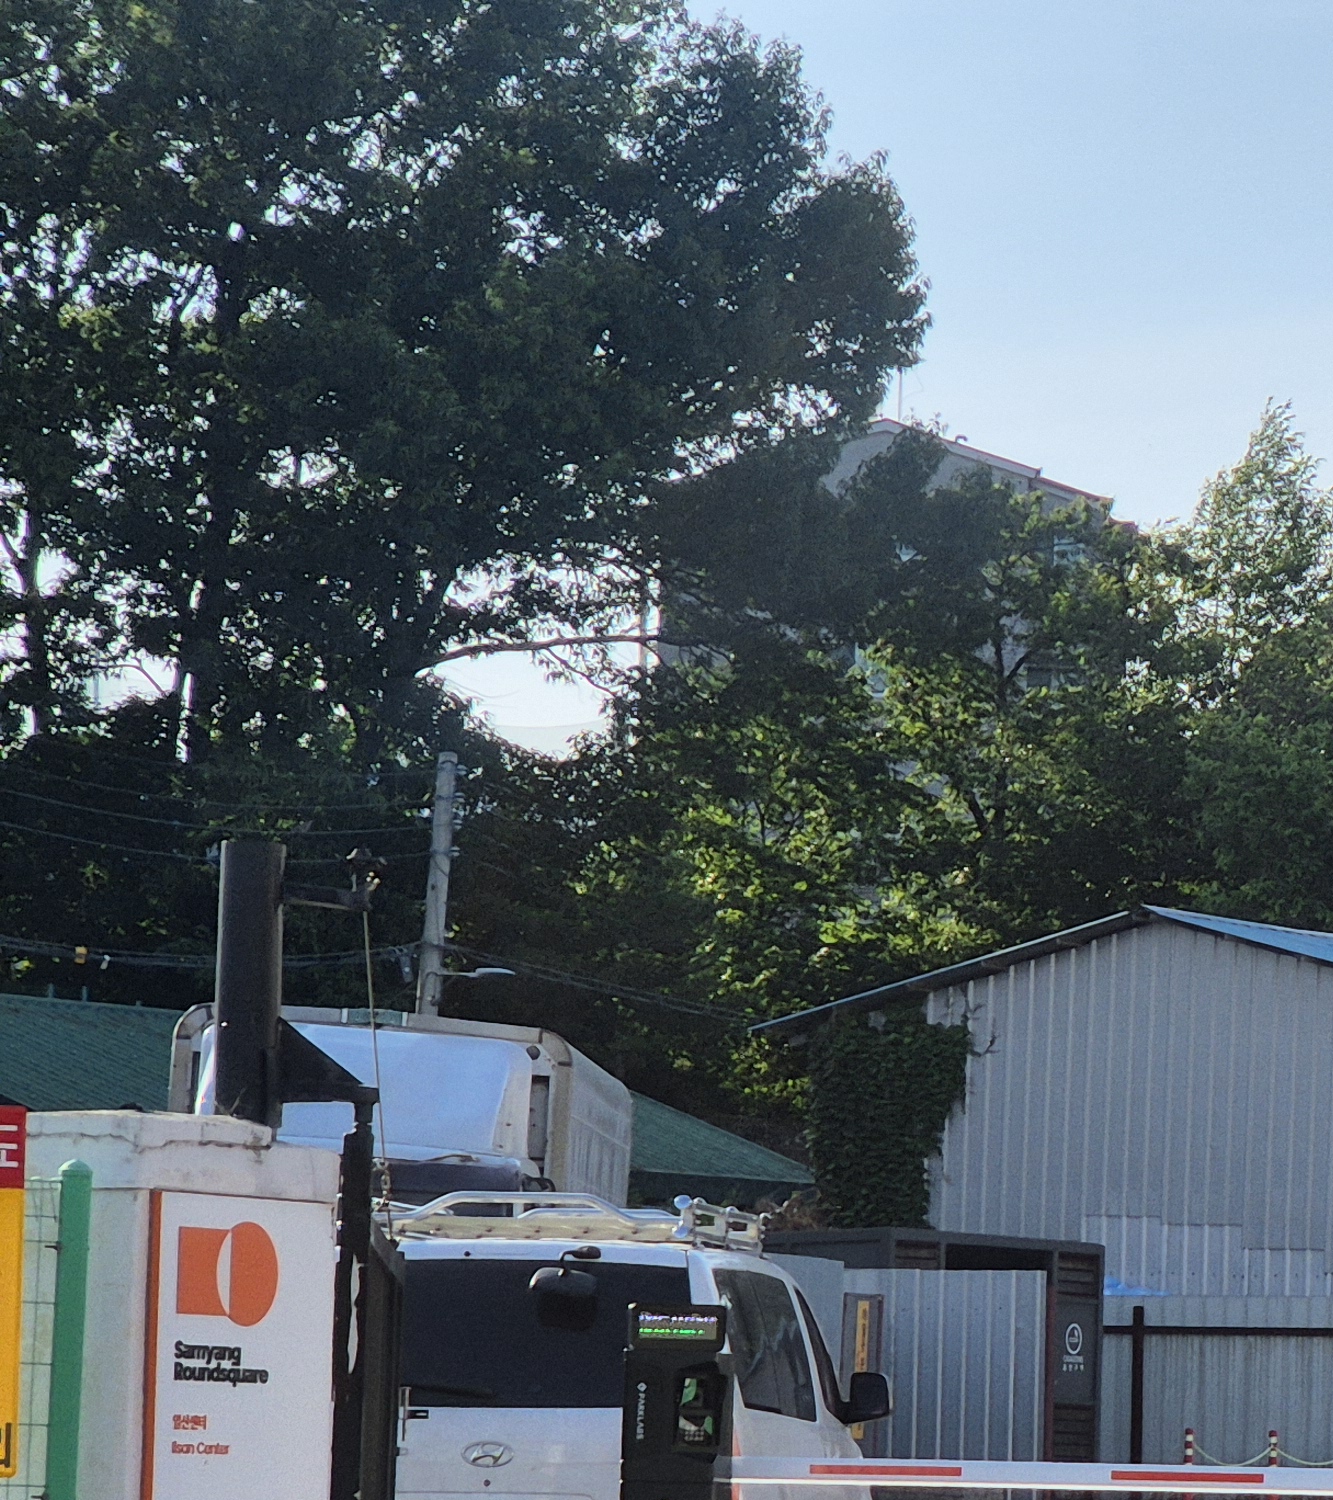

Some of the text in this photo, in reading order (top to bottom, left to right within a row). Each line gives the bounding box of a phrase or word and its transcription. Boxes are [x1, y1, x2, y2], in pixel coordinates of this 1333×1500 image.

[174, 1340, 242, 1366] Samyang
[173, 1361, 269, 1387] Roundsquare
[636, 1392, 646, 1440] PARKLABS
[197, 1442, 230, 1455] Center
